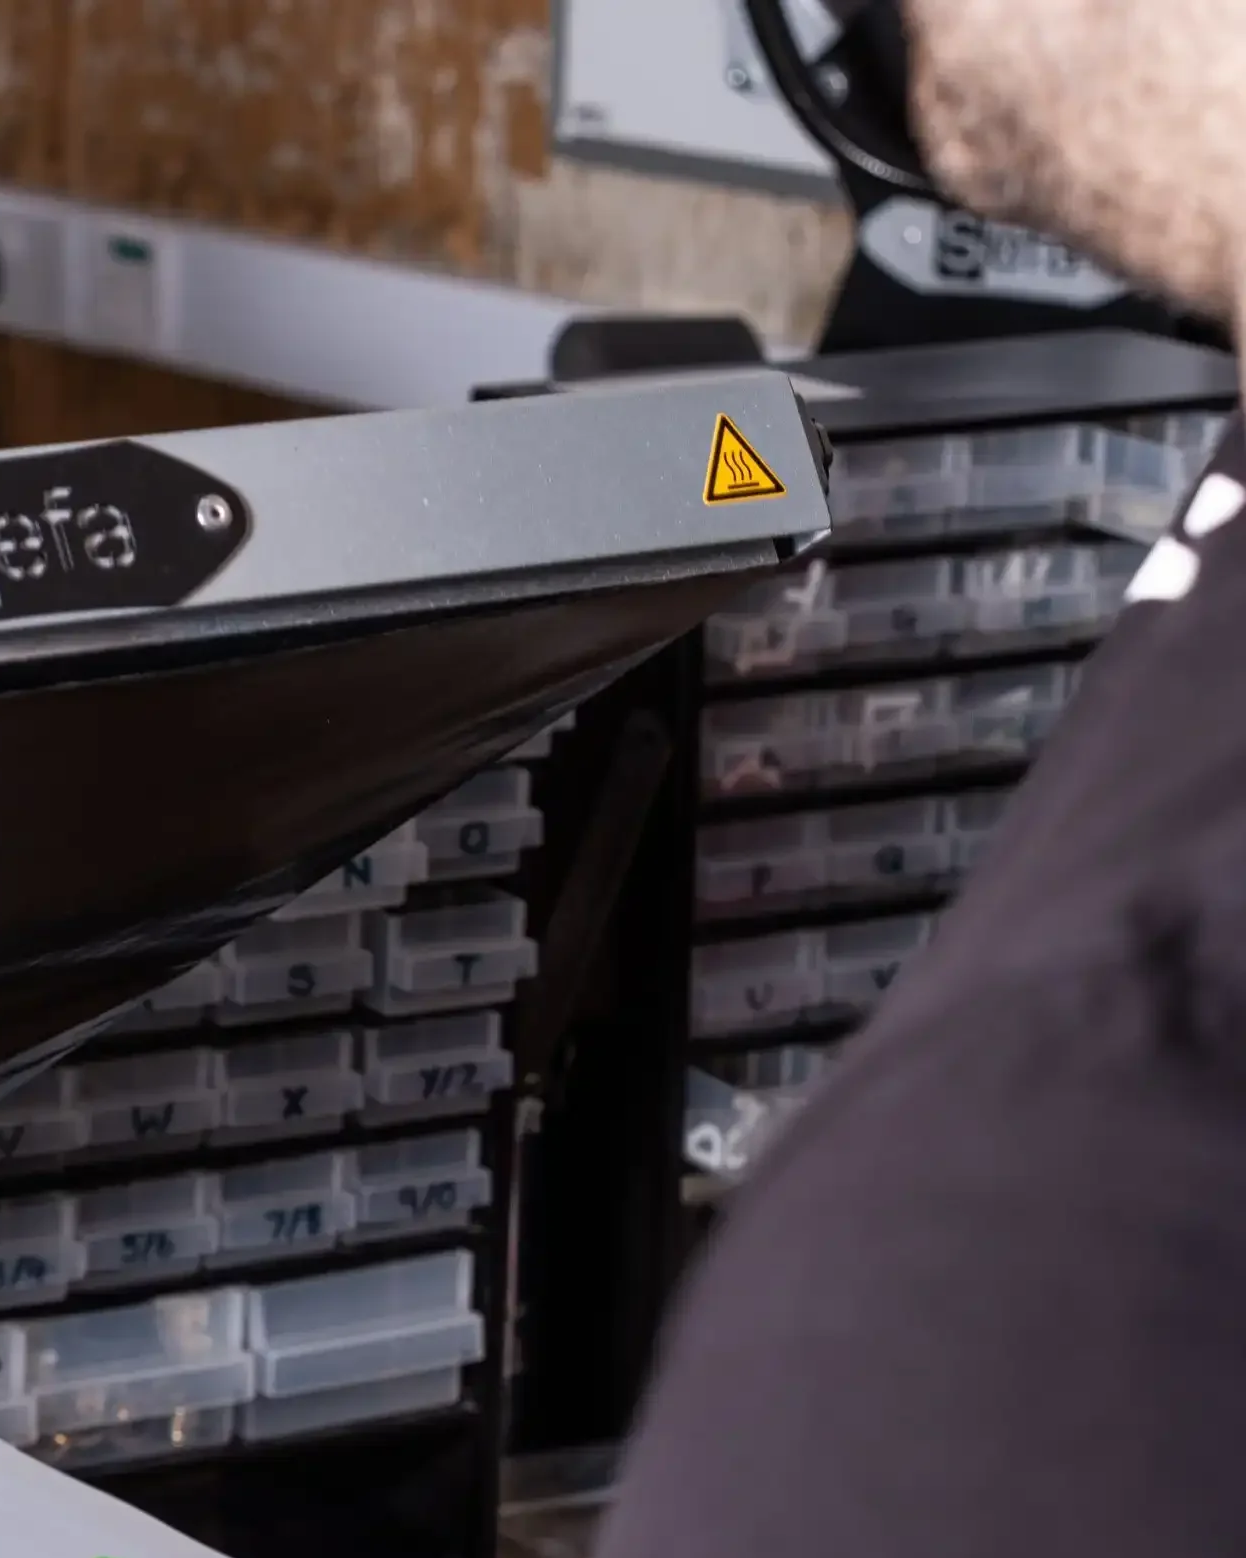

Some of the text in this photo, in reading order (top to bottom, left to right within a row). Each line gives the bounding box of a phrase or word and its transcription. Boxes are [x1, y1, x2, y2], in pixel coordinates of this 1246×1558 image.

[343, 855, 373, 888] N
[286, 962, 317, 996] S
[454, 952, 483, 985] T
[282, 1085, 309, 1120] X
[131, 1102, 175, 1139] W
